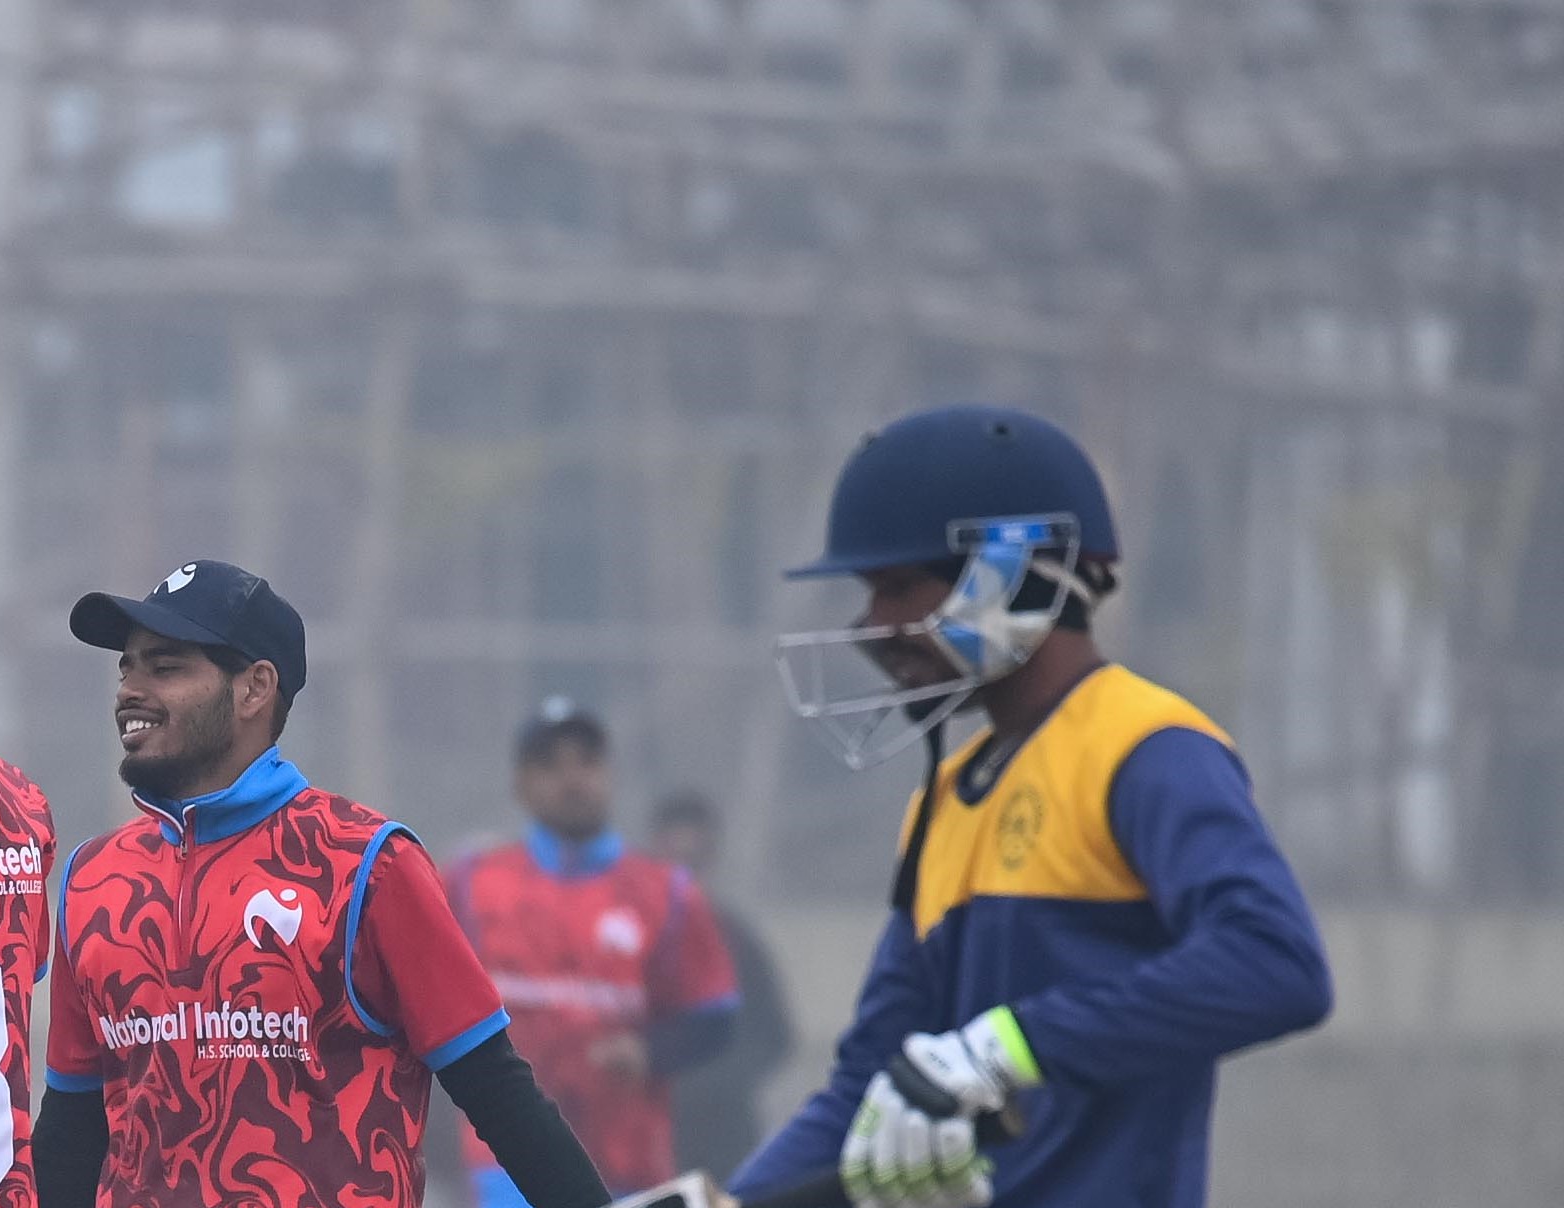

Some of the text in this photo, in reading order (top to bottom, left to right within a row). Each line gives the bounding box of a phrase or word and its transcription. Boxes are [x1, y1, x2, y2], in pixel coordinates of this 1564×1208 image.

[9, 880, 16, 895] &
[194, 1001, 309, 1042] Infotech
[197, 1044, 311, 1062] H.S. SCHOOL & COLLGE
